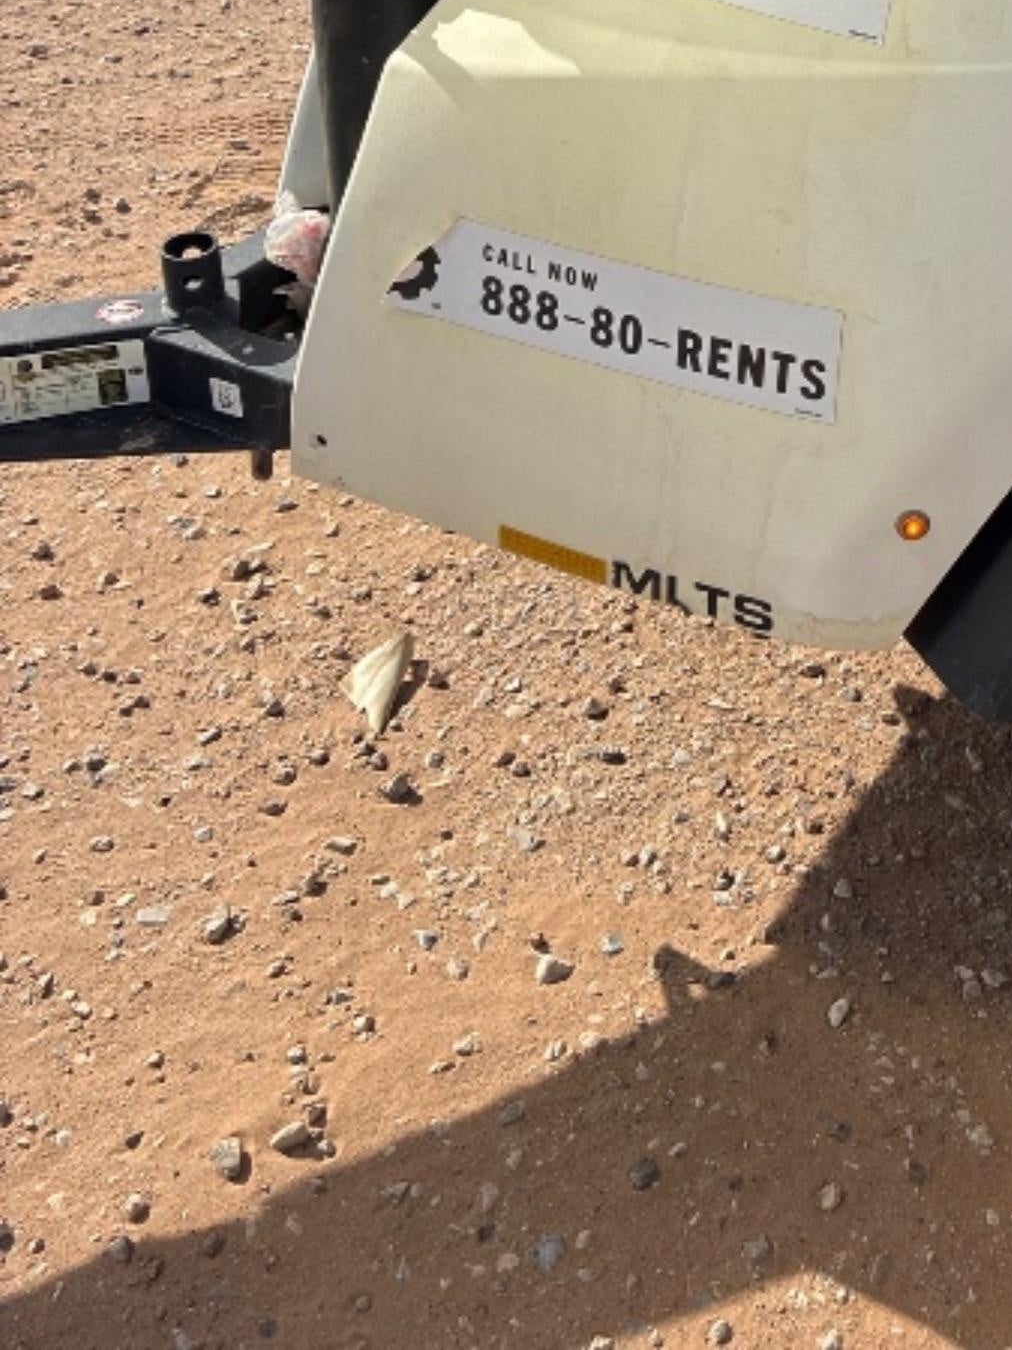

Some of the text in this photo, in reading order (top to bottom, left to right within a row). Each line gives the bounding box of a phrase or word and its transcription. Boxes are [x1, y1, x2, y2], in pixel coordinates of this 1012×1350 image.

[481, 243, 599, 292] CALL NOW
[480, 275, 827, 400] 888-80-RENTS
[612, 560, 774, 632] MLTS
